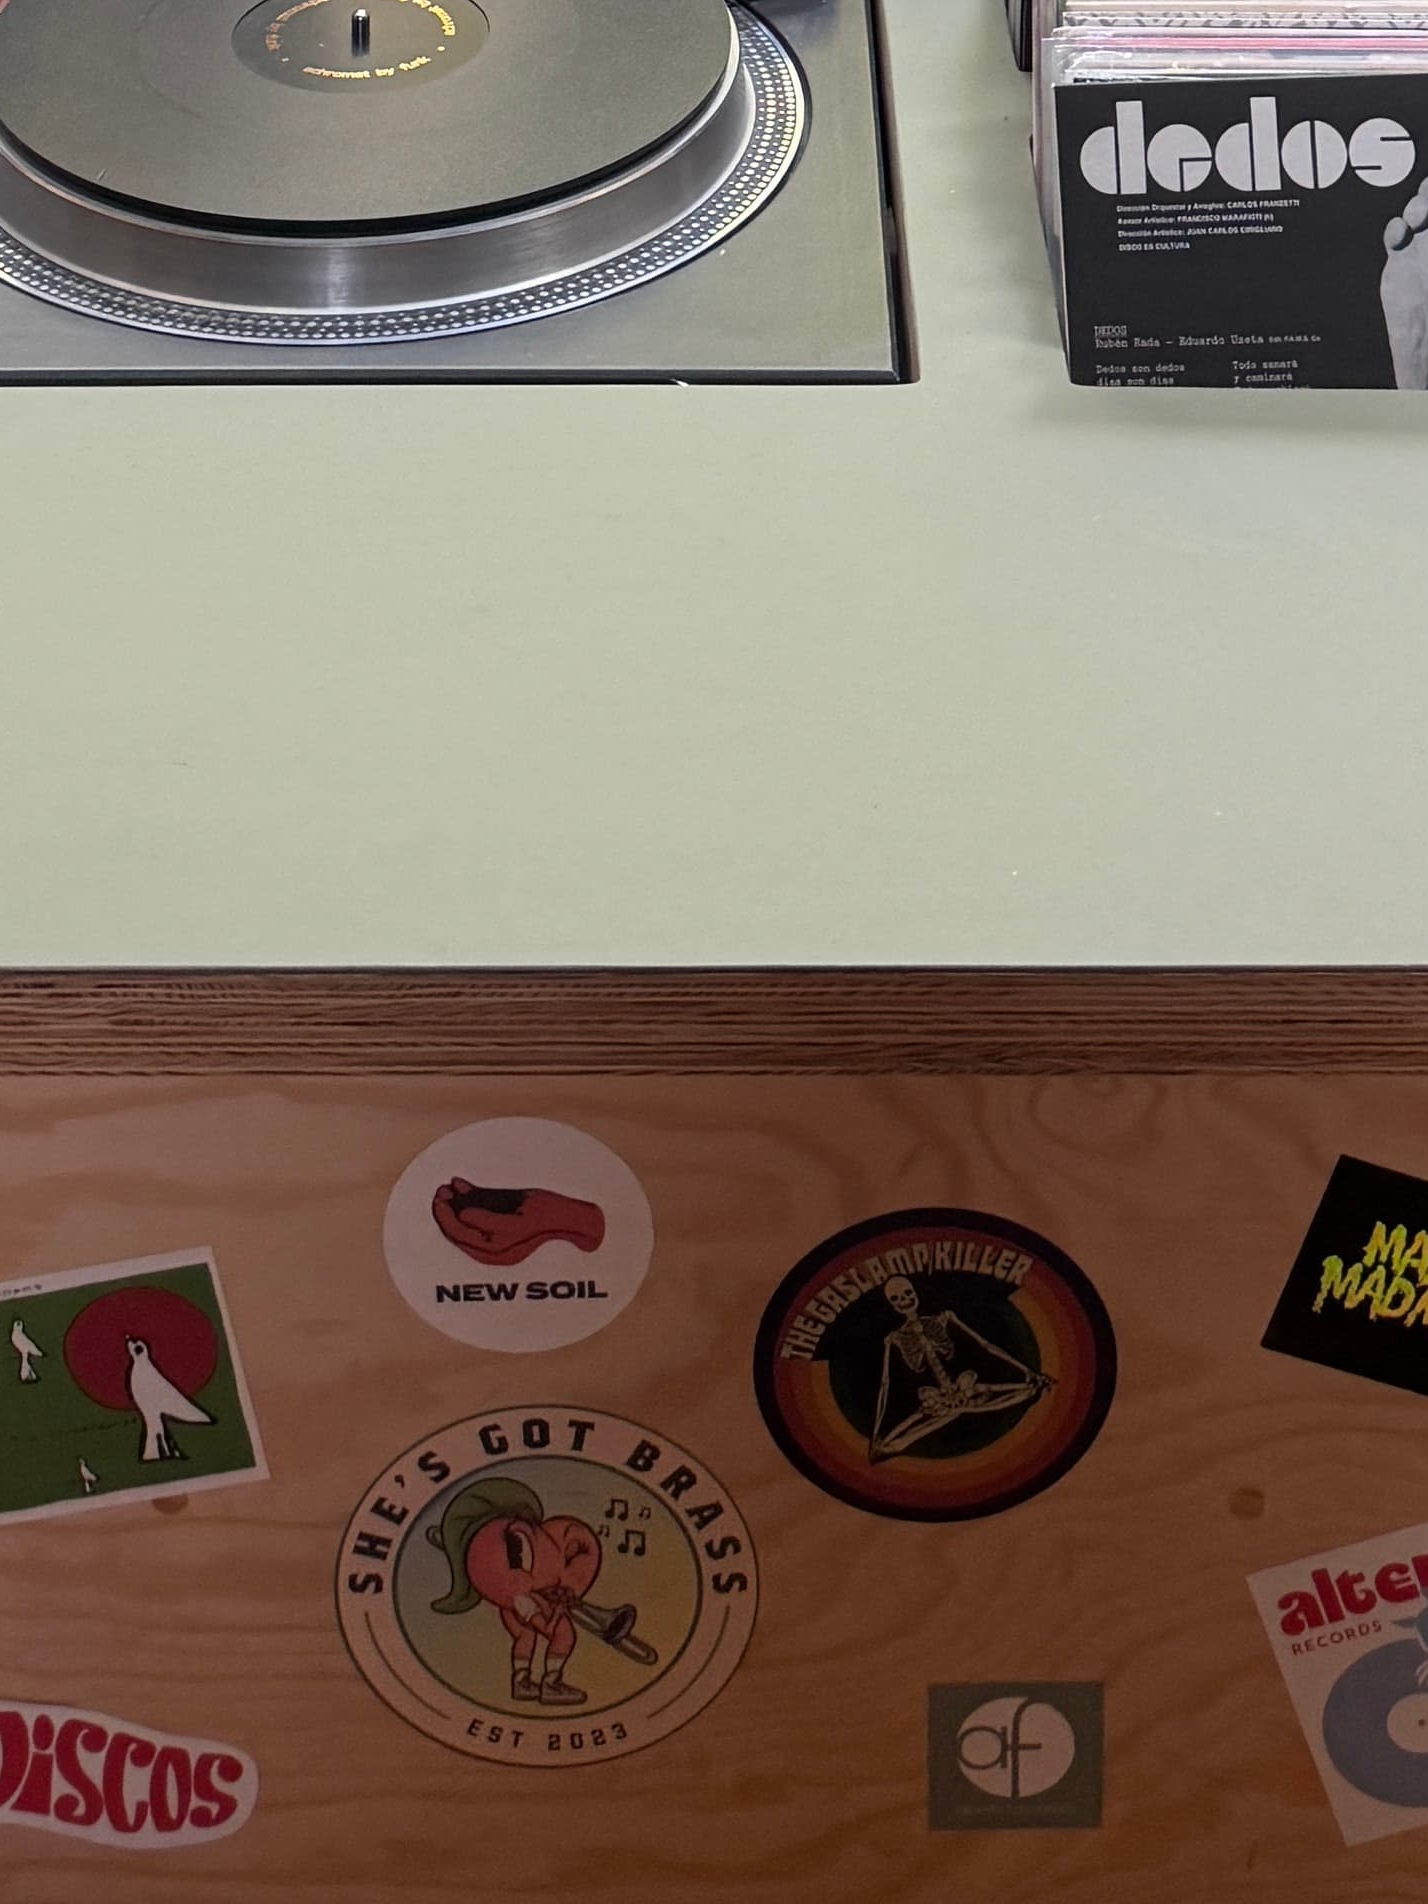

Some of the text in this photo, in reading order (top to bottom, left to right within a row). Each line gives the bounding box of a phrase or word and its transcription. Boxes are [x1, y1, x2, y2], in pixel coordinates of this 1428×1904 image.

[1079, 96, 1416, 195] dedos
[1177, 214, 1220, 223] FRANCISCO
[1178, 334, 1225, 346] Eduardo
[435, 1279, 609, 1303] NEW SOIL
[780, 1299, 826, 1362] THE
[933, 1241, 1034, 1287] KILLER
[1312, 1254, 1415, 1323] MAD
[348, 1417, 749, 1596] SHE'S GOT BRASS
[1290, 1619, 1384, 1656] RECORDS
[466, 1717, 628, 1752] EST 2023
